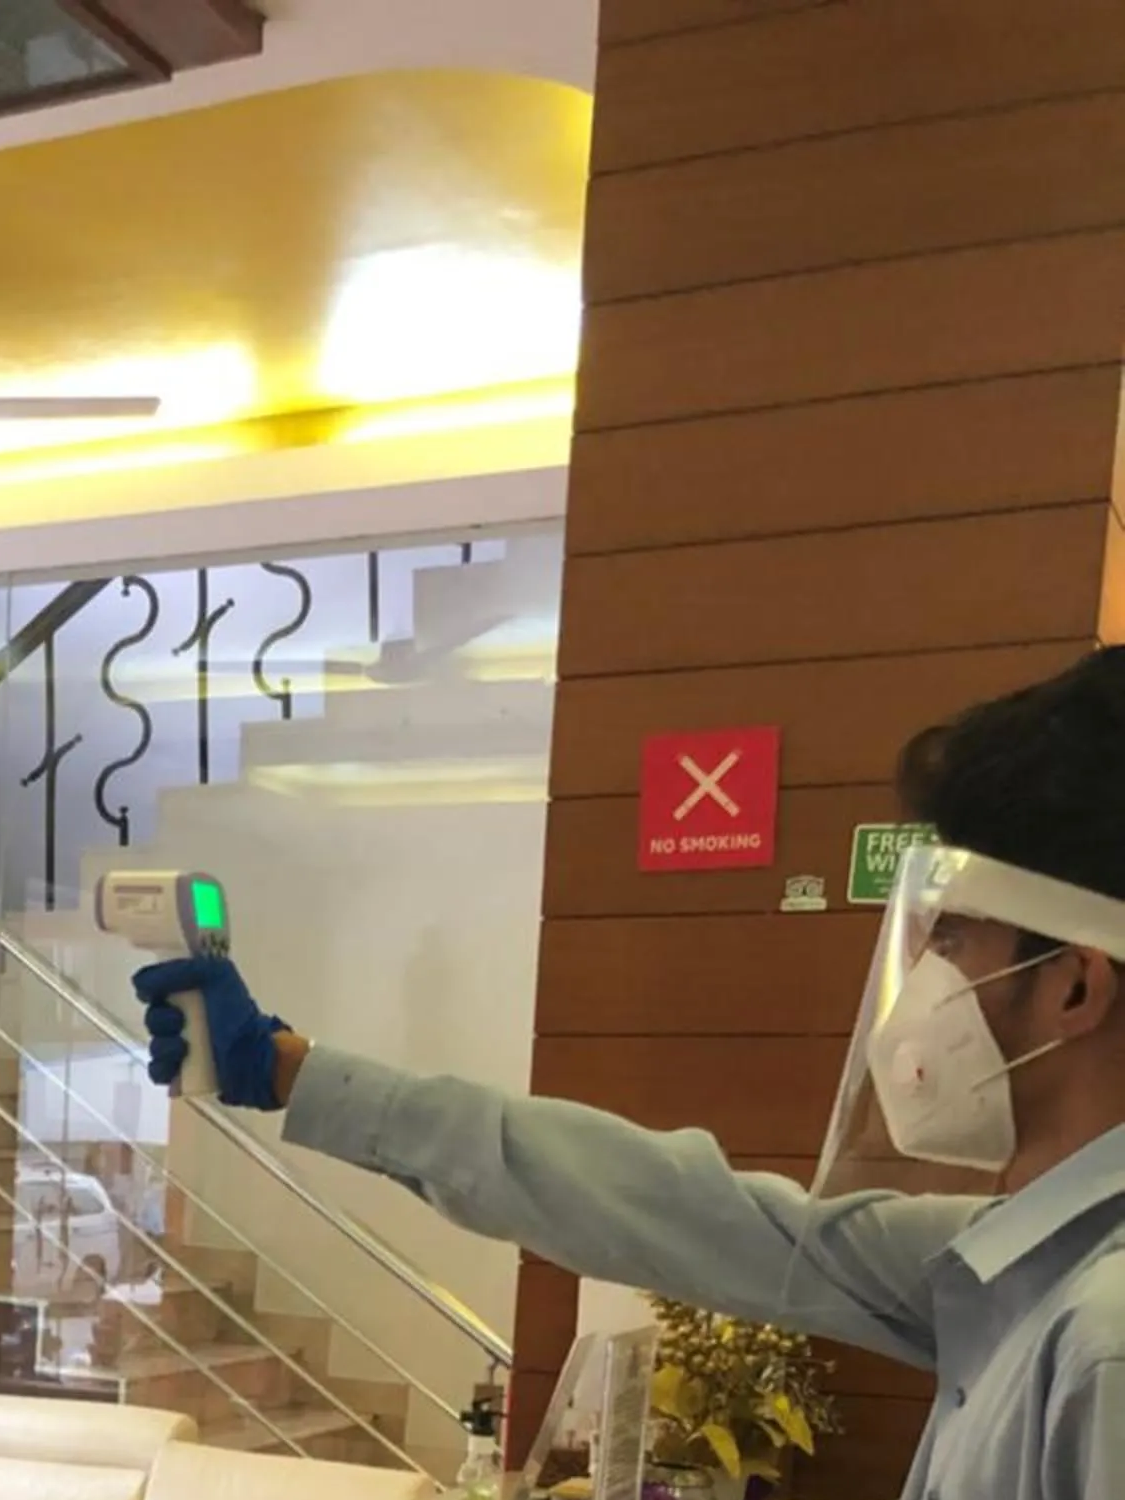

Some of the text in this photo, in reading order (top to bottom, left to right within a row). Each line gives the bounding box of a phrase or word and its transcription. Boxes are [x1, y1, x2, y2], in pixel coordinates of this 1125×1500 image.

[650, 833, 761, 854] NO SMOKING
[867, 832, 924, 852] FREE
[867, 854, 896, 873] WI
